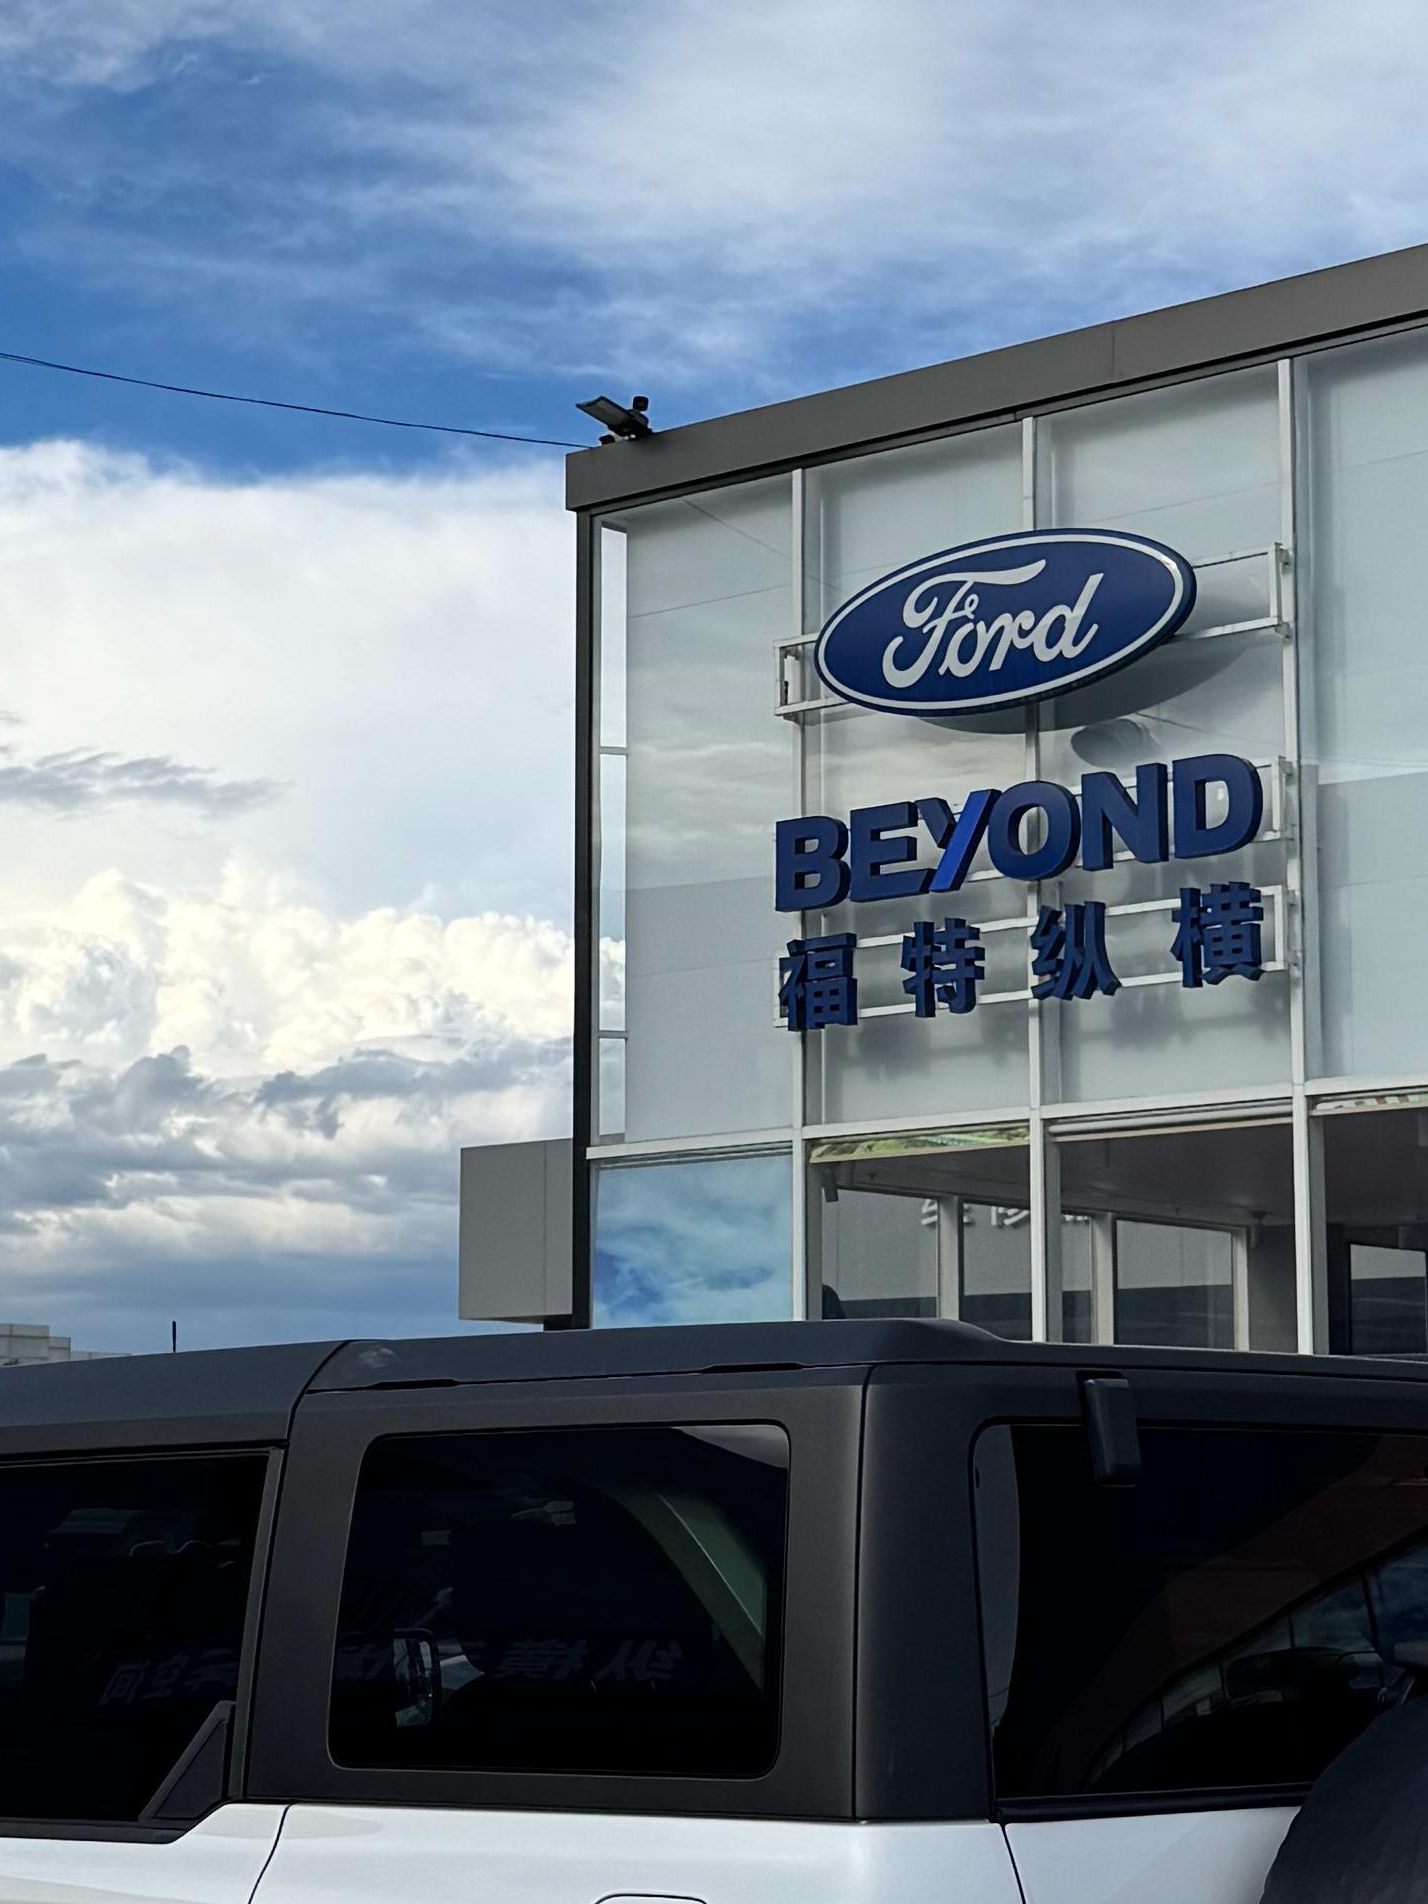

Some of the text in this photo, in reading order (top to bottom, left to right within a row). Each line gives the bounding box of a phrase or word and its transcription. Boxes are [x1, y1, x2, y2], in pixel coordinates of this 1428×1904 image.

[882, 559, 1104, 688] Ford
[775, 753, 1264, 912] BEYOND
[778, 881, 1265, 1032] 福特纵横
